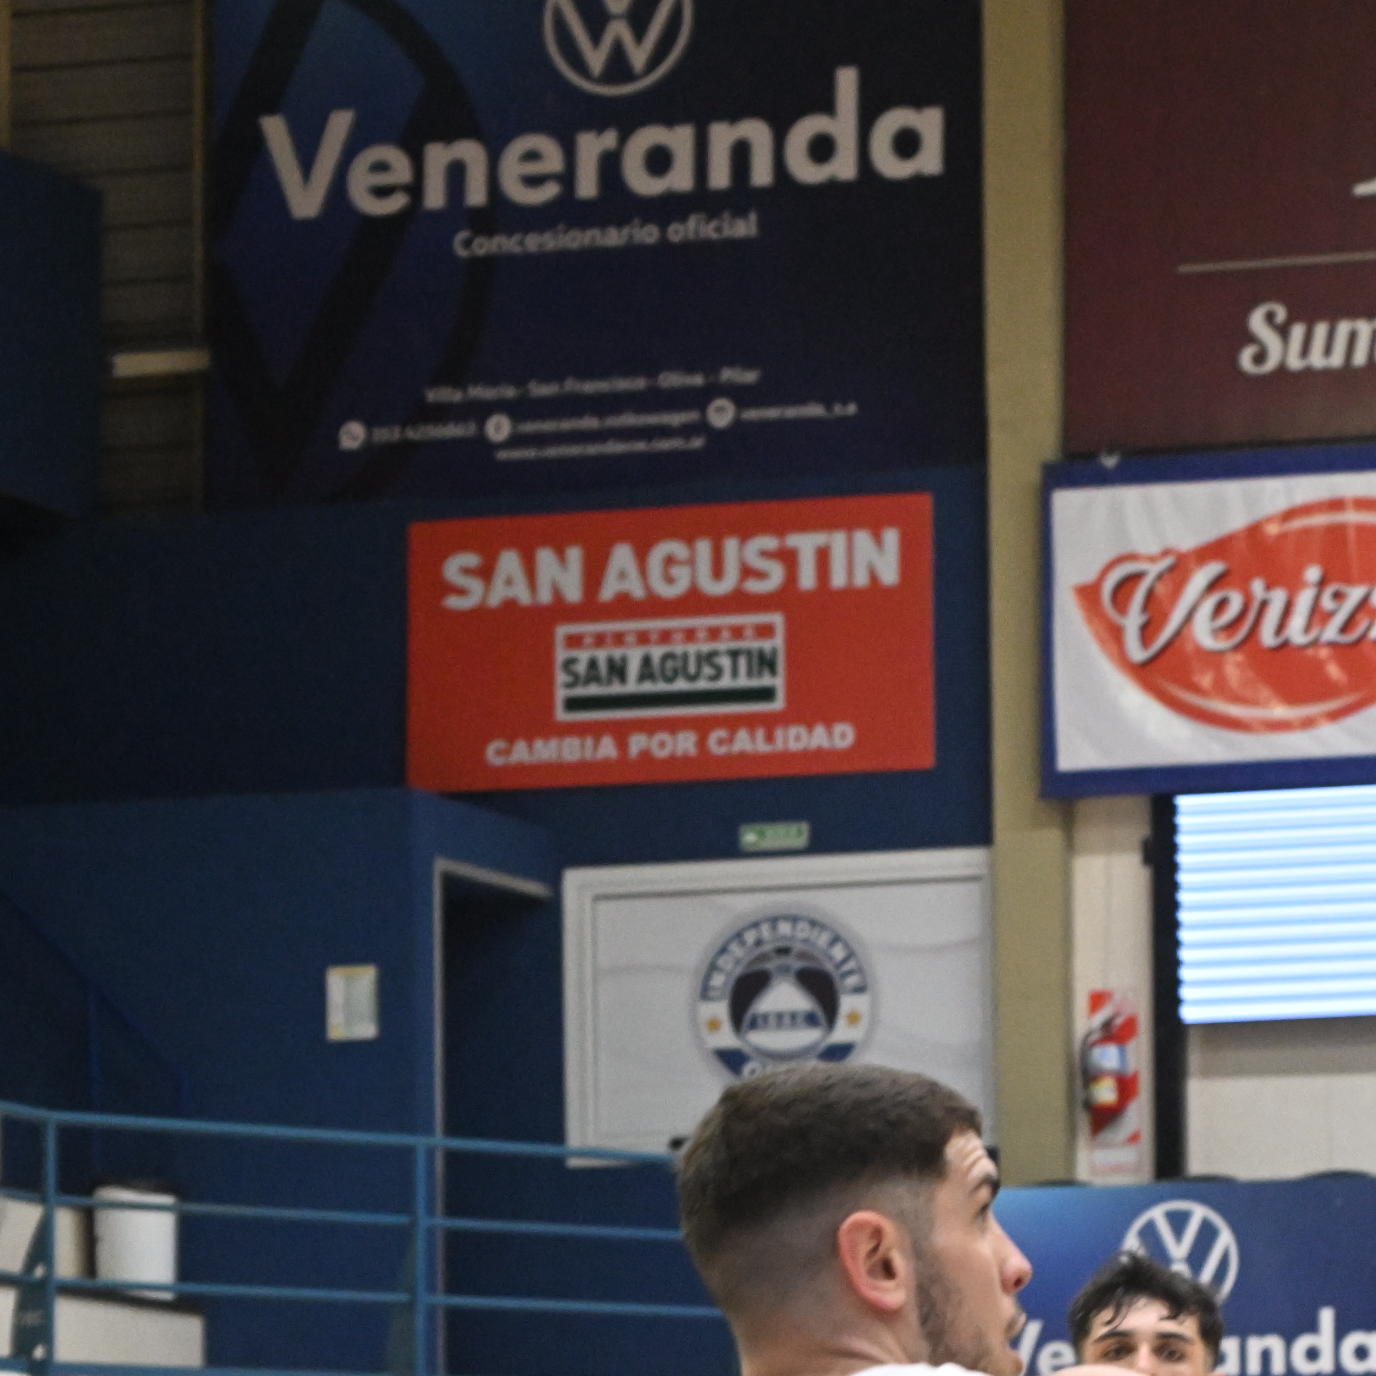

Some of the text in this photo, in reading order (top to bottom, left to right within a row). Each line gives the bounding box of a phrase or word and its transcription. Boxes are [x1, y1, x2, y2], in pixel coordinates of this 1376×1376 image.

[260, 66, 945, 219] Veneranda
[453, 209, 758, 258] Concesionario oficial
[442, 528, 901, 611] SAN AGUSTIN
[561, 645, 779, 690] SAN AGUSTIN
[485, 722, 857, 767] CAMBIA POR CALIDAD
